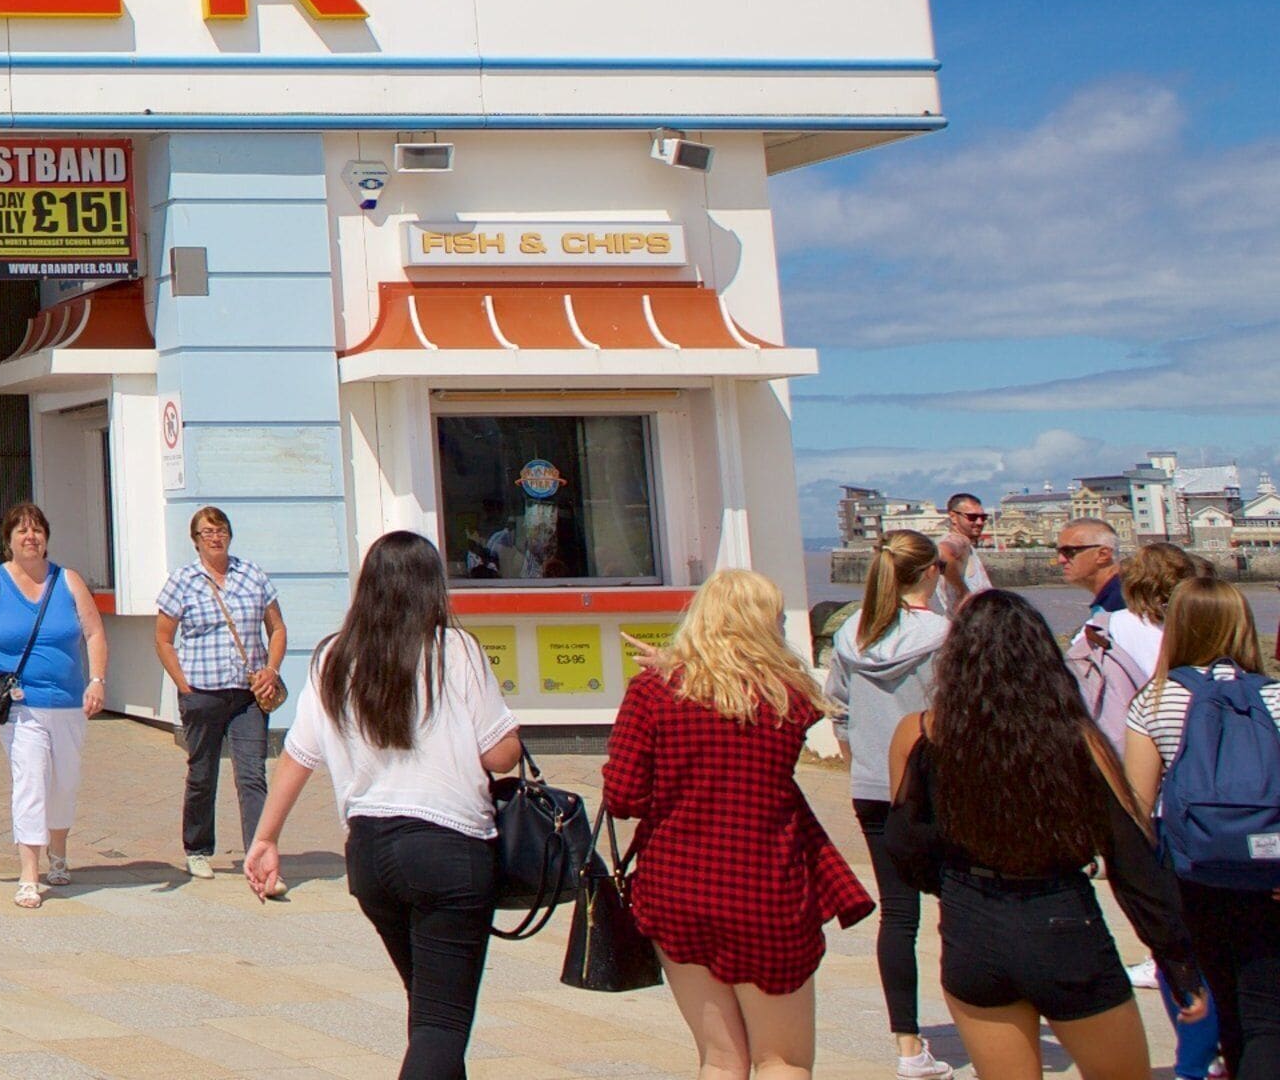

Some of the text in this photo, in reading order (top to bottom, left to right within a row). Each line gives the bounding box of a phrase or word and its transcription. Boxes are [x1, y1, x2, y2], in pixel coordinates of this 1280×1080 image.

[32, 190, 123, 233] £15!
[65, 238, 90, 246] SCHOOL
[422, 232, 672, 255] FISH & CHIPS
[8, 263, 129, 275] WWW.GRANDPIER.CO.UK
